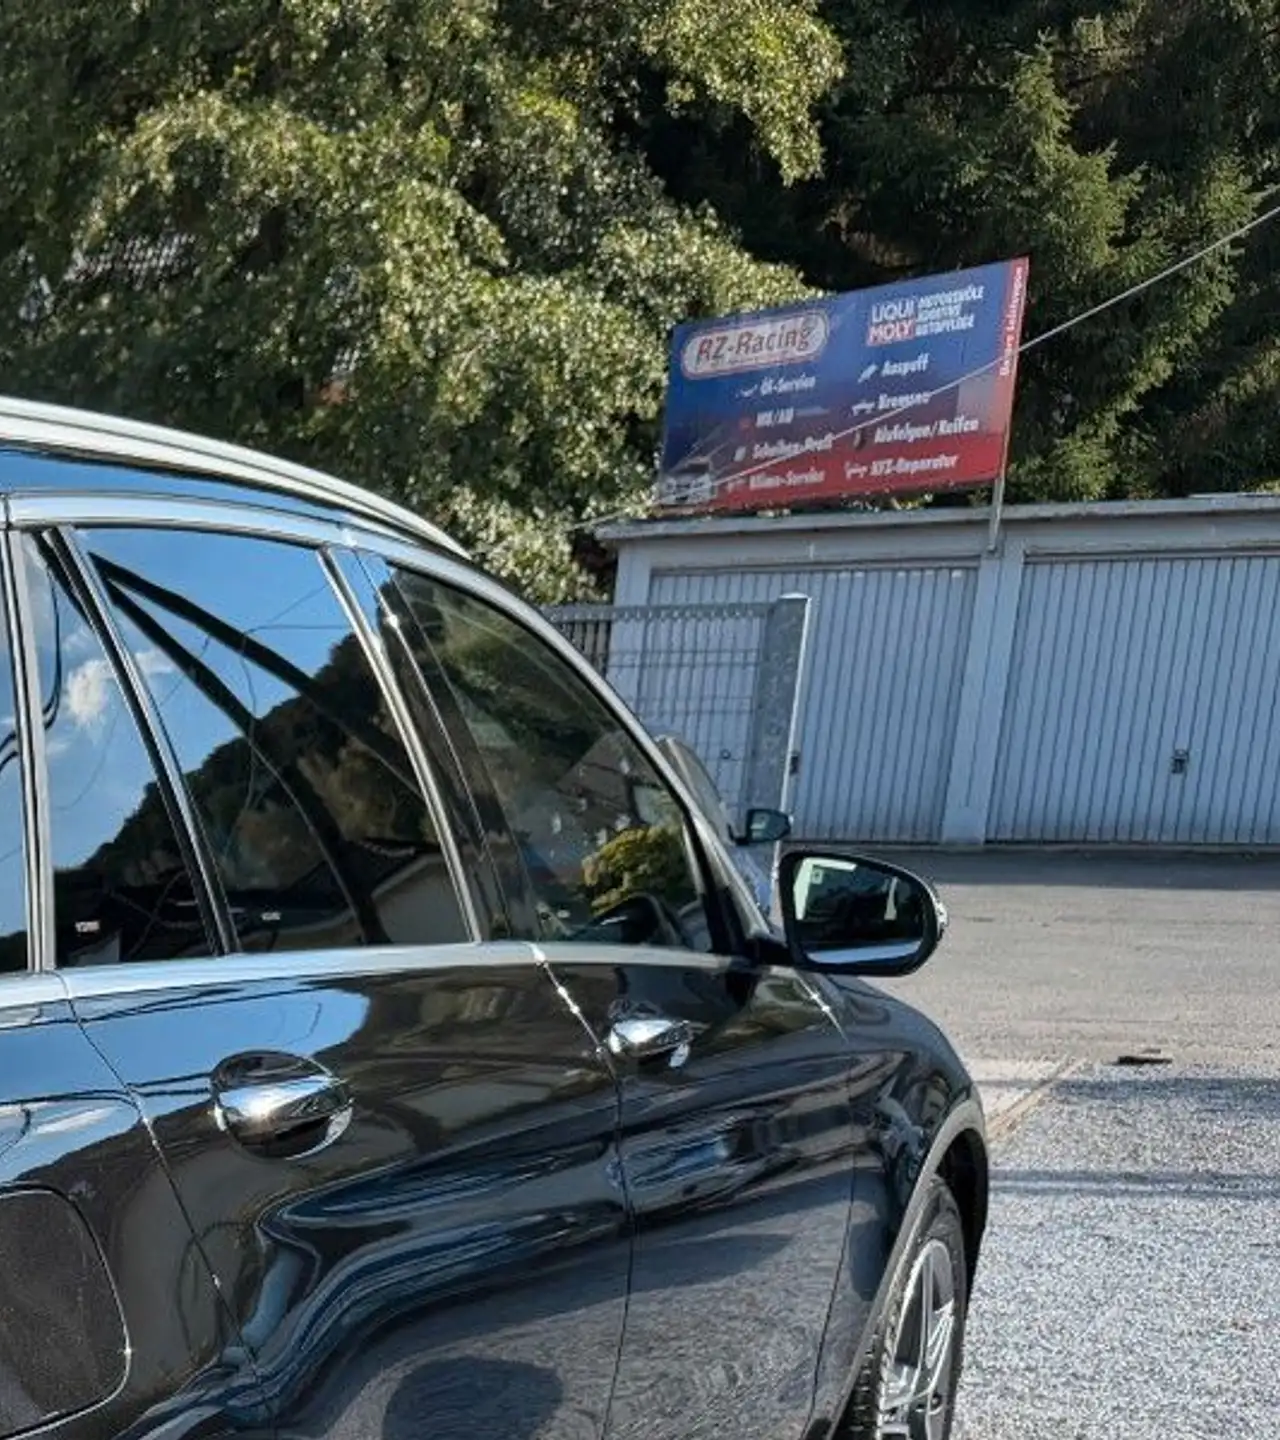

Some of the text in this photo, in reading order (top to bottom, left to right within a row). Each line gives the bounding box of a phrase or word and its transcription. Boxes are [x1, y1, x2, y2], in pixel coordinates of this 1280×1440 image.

[871, 299, 916, 323] LIQUI
[867, 320, 915, 345] MOLY
[695, 324, 812, 367] RZ-Racing
[881, 353, 930, 377] Auspuff
